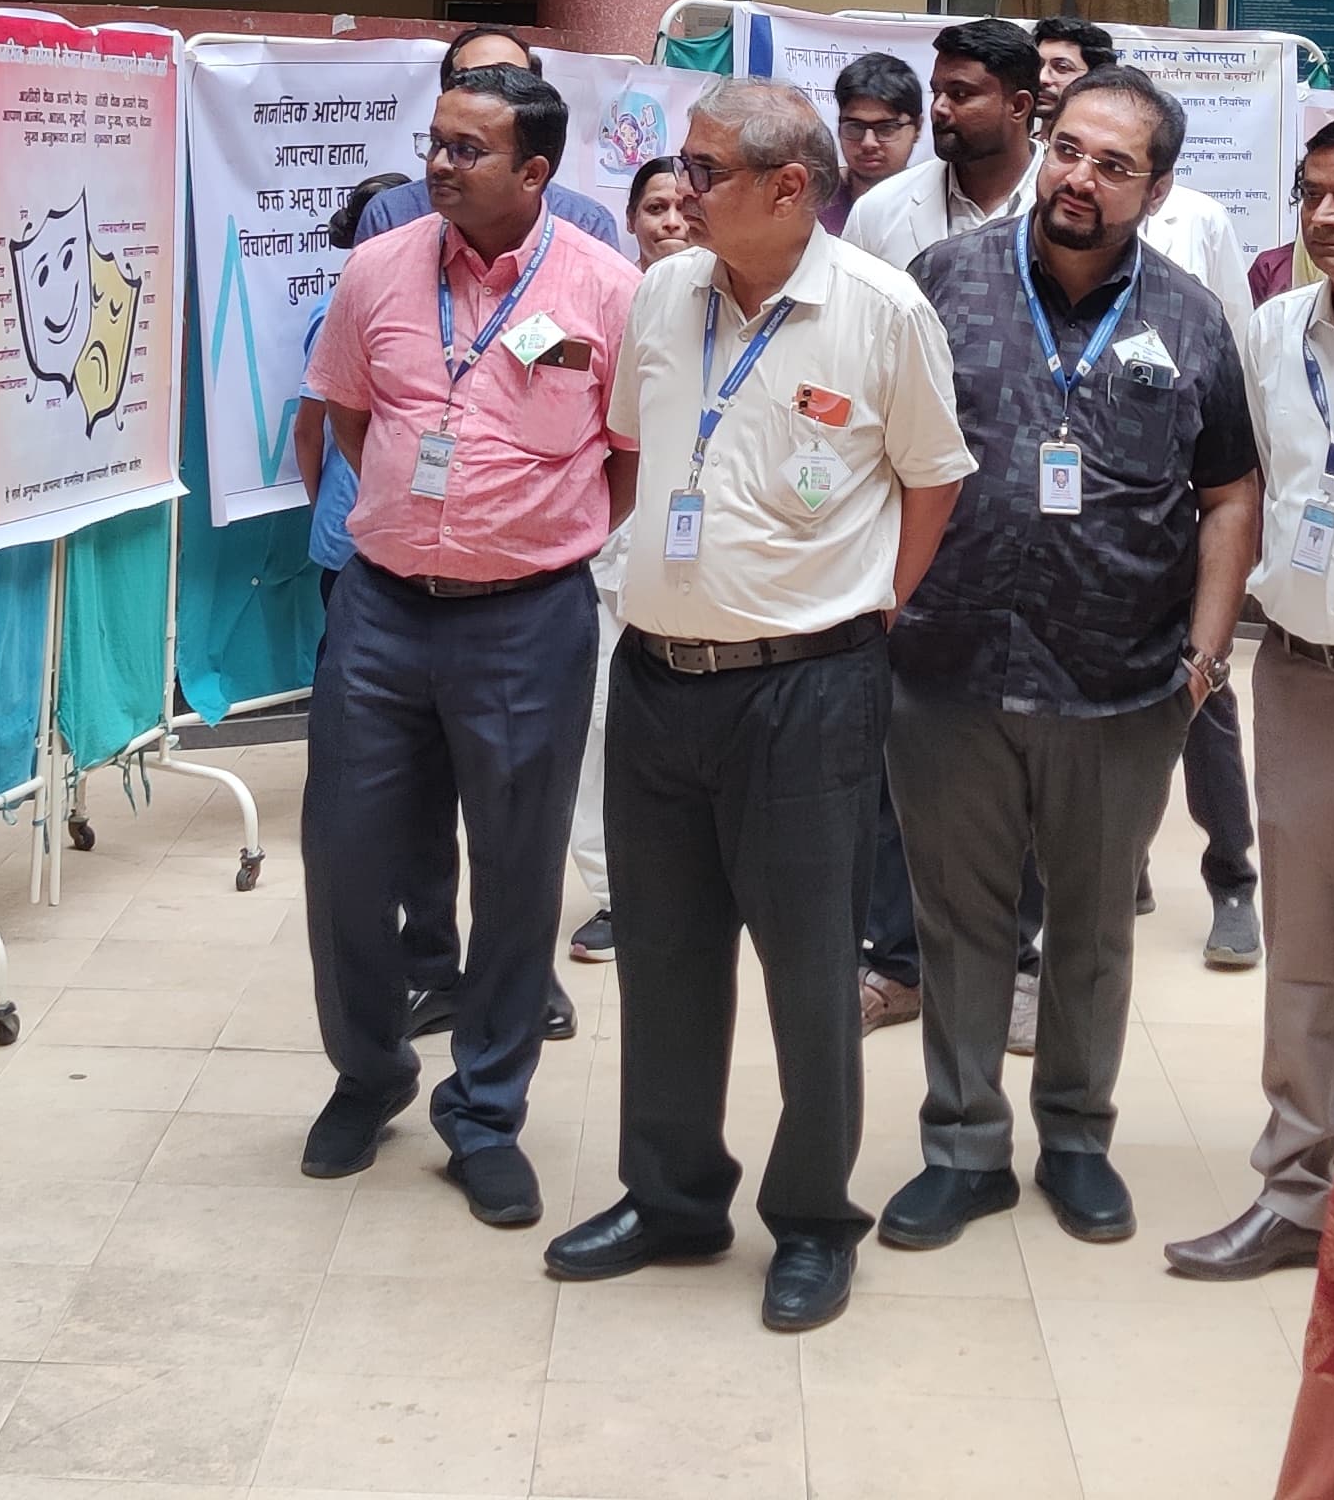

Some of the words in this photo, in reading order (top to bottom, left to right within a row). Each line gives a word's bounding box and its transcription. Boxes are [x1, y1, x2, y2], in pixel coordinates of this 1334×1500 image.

[1132, 46, 1179, 63] आरोग्य
[1183, 47, 1246, 69] जोपासूया
[253, 96, 310, 125] मानसिक
[312, 94, 362, 124] आरोग्य
[364, 94, 398, 122] असते
[274, 144, 325, 168] आपल्या
[328, 143, 369, 168] हातात,
[256, 188, 285, 212] फक्त
[289, 188, 318, 217] असू
[239, 229, 293, 259] विचारांना
[298, 224, 331, 253] आणि
[287, 268, 325, 305] तुमची
[763, 305, 789, 338] MEDICAL
